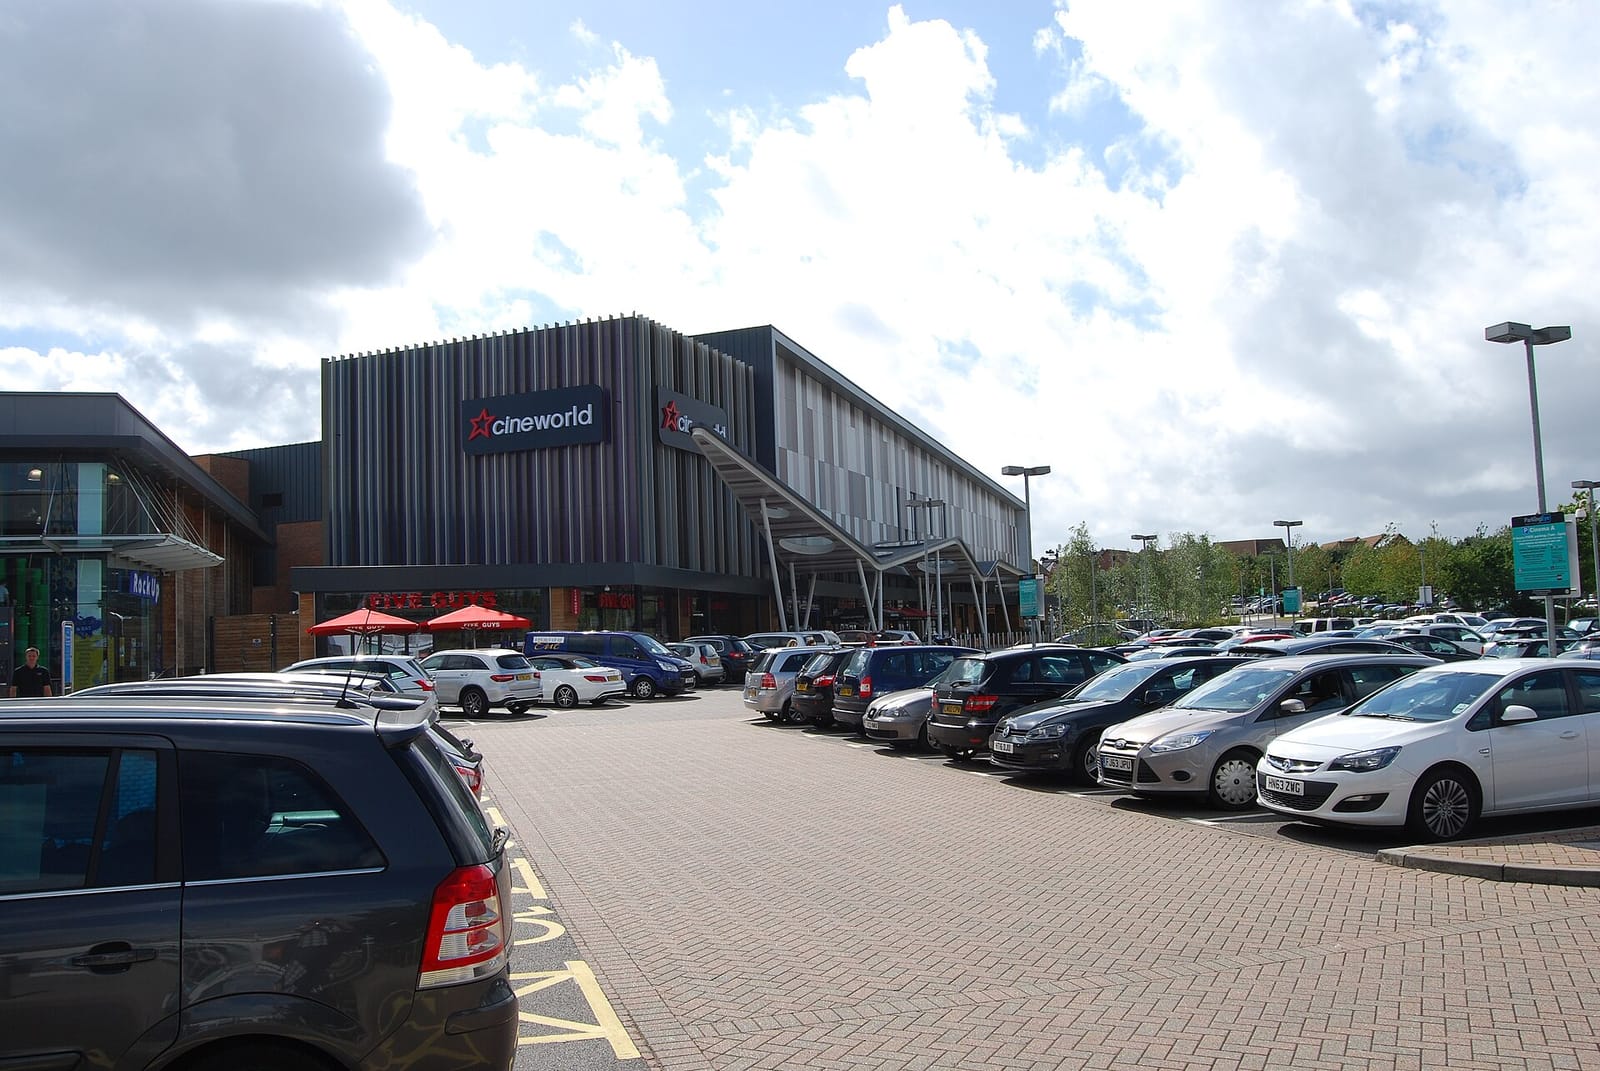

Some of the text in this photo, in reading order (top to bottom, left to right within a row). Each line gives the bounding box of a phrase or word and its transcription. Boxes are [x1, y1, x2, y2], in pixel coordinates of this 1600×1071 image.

[492, 403, 592, 435] cineworld
[369, 591, 497, 609] FIVE GUYS
[1267, 777, 1300, 793] HN63 ZWG
